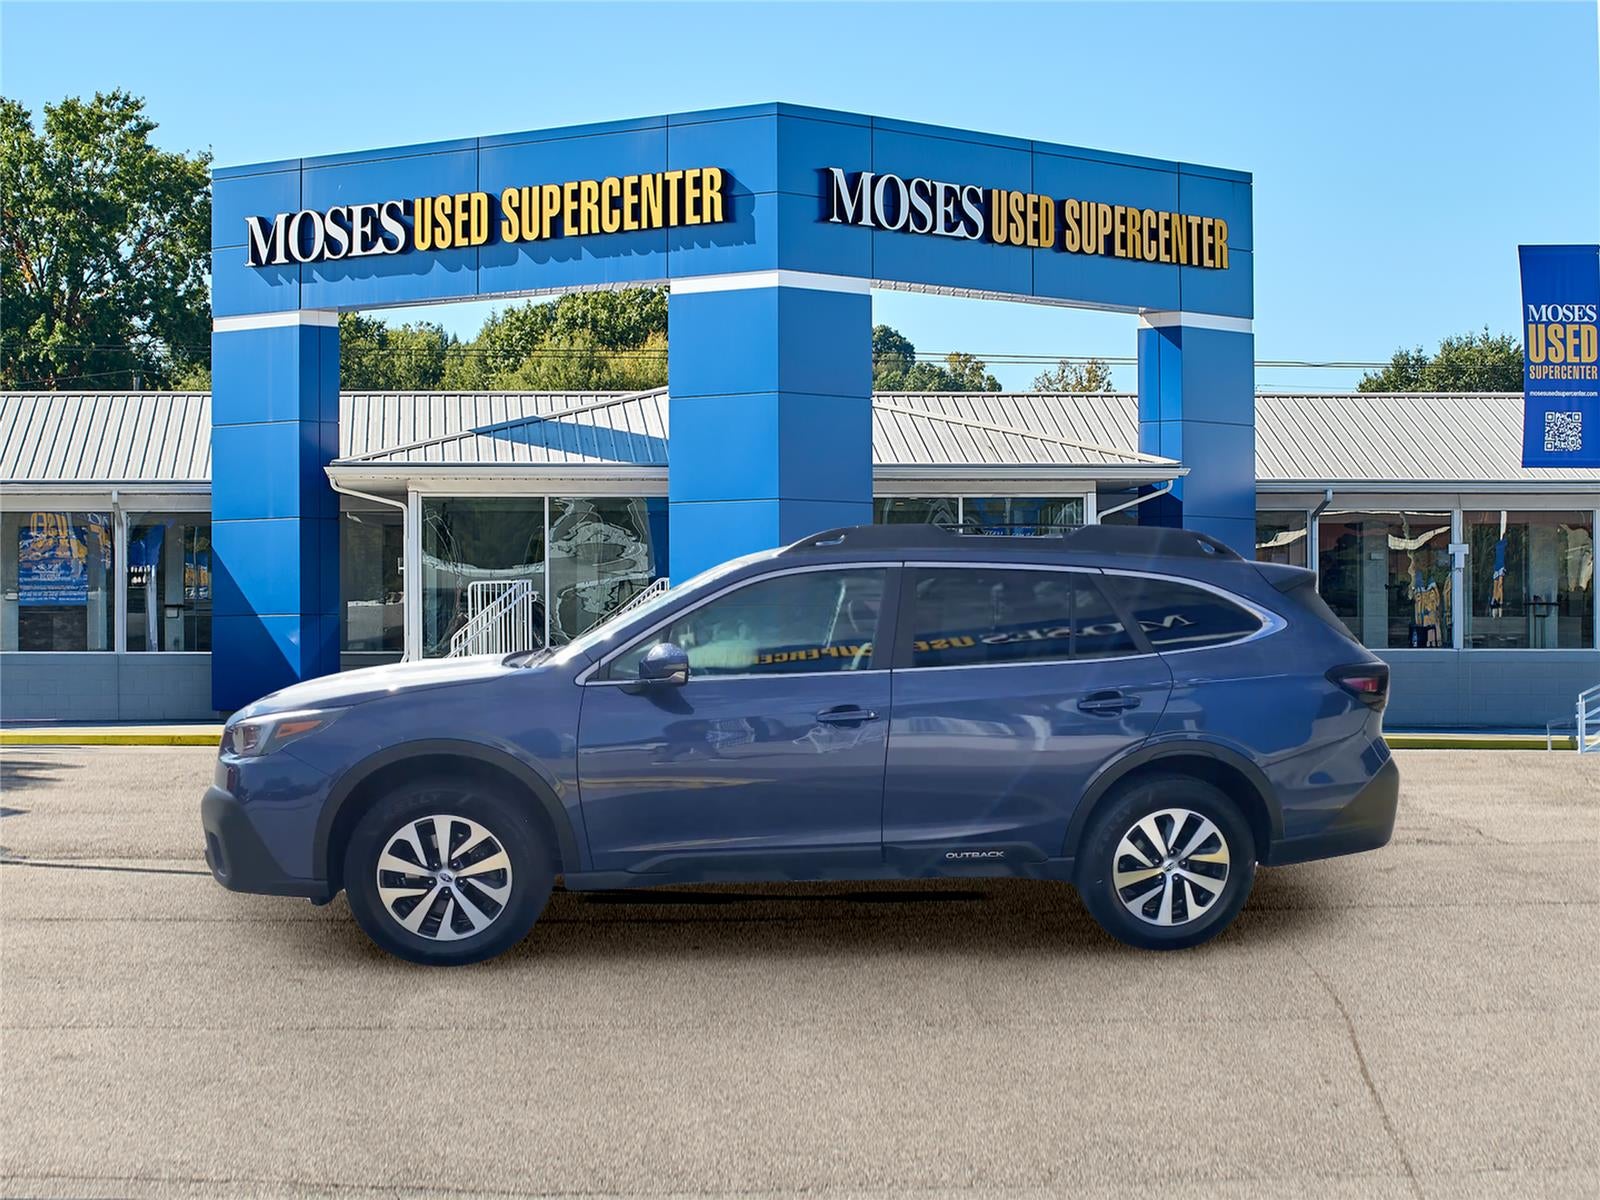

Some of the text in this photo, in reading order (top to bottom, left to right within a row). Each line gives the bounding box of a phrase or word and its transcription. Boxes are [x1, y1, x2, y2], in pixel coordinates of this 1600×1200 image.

[245, 167, 724, 267] MOSES USED SUPERCENTER
[829, 167, 1229, 269] MOSES USED SUPERCENTER
[1528, 304, 1597, 322] MOSES
[1528, 324, 1598, 363] USED
[1529, 365, 1598, 379] SUPERCENTER
[945, 851, 1004, 859] OUTBACK
